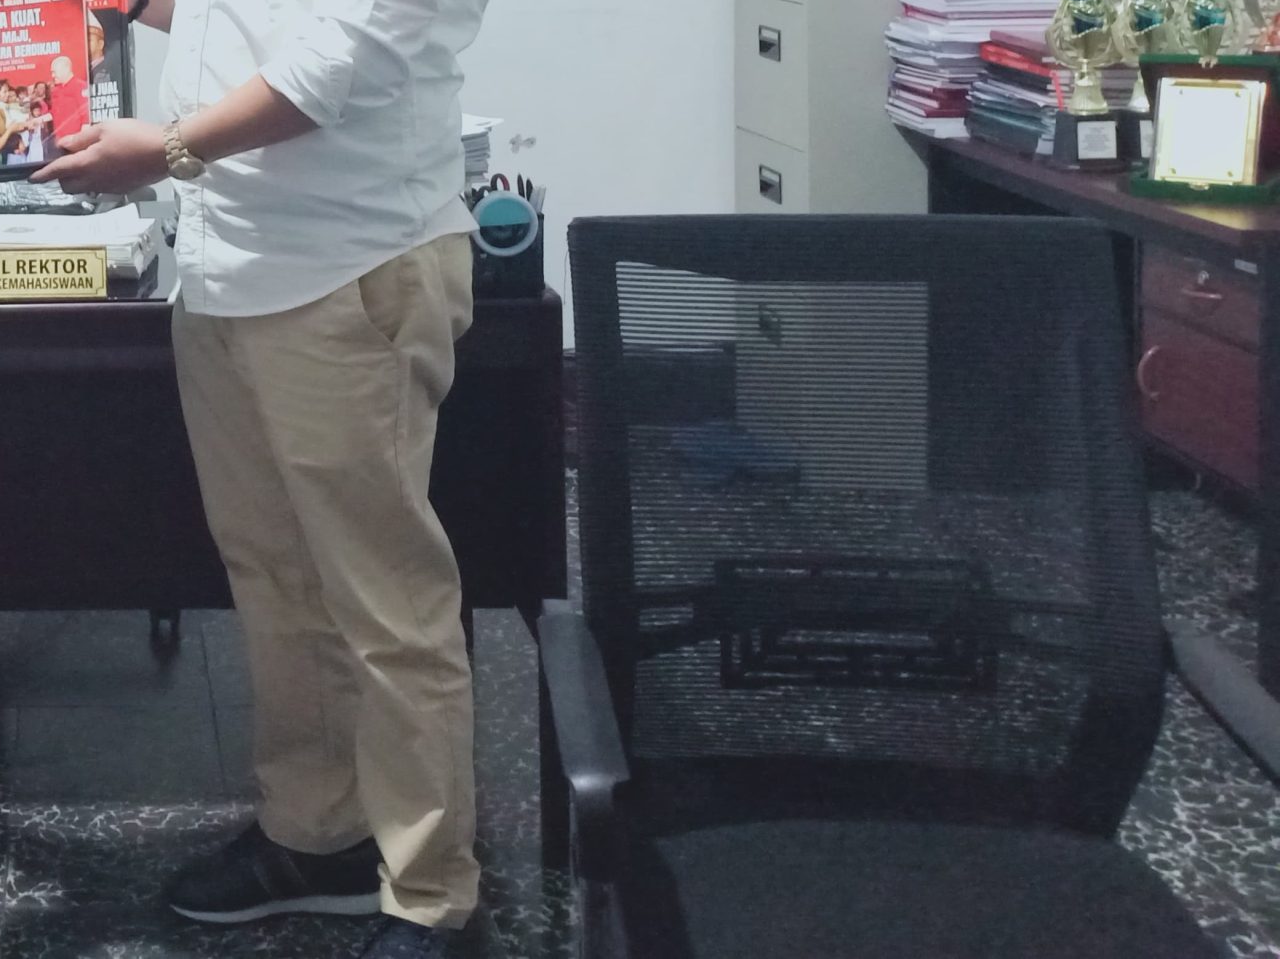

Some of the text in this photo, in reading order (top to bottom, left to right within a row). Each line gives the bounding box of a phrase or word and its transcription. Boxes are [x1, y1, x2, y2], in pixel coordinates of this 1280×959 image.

[10, 8, 45, 28] KUAT,
[2, 29, 32, 44] MAJU,
[14, 41, 60, 58] BERDIKARI
[98, 81, 118, 96] JUAL
[16, 258, 88, 274] REKTOR
